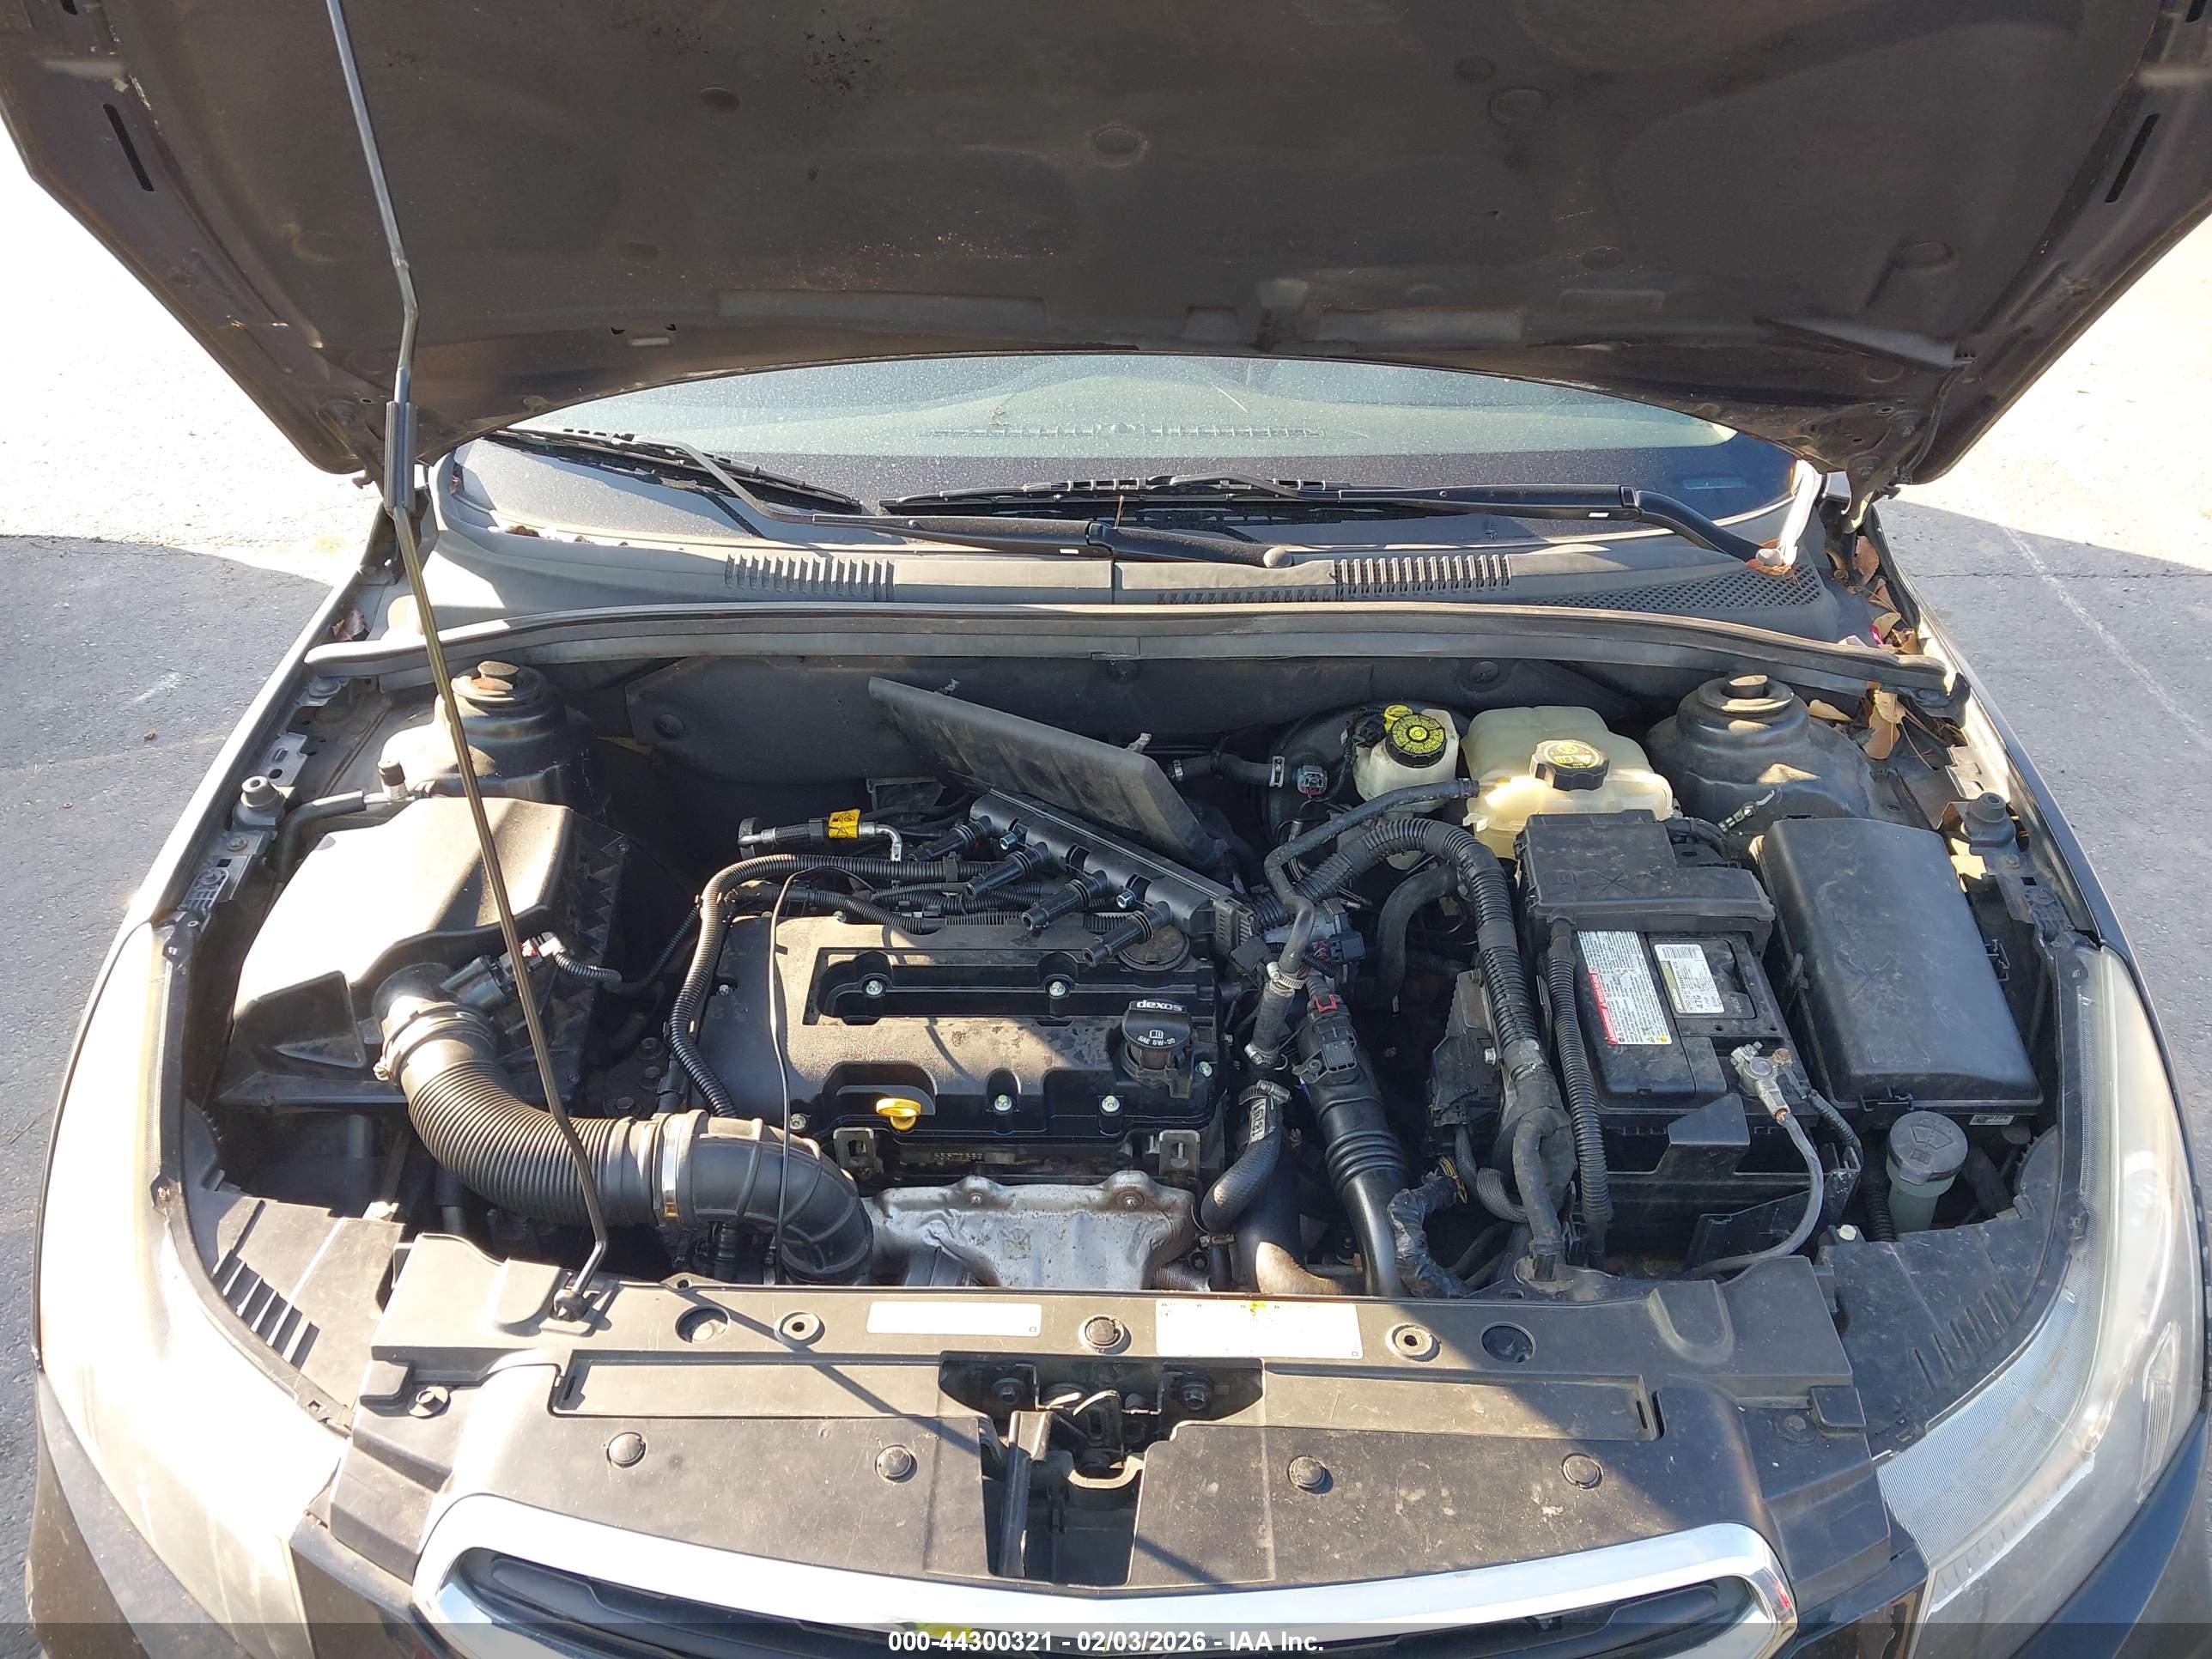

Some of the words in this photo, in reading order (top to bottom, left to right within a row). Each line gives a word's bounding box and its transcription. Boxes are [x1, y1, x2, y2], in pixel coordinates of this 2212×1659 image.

[1136, 1000, 1183, 1012] dexos
[1137, 1035, 1151, 1045] SAE
[1152, 1037, 1176, 1046] 5W-30
